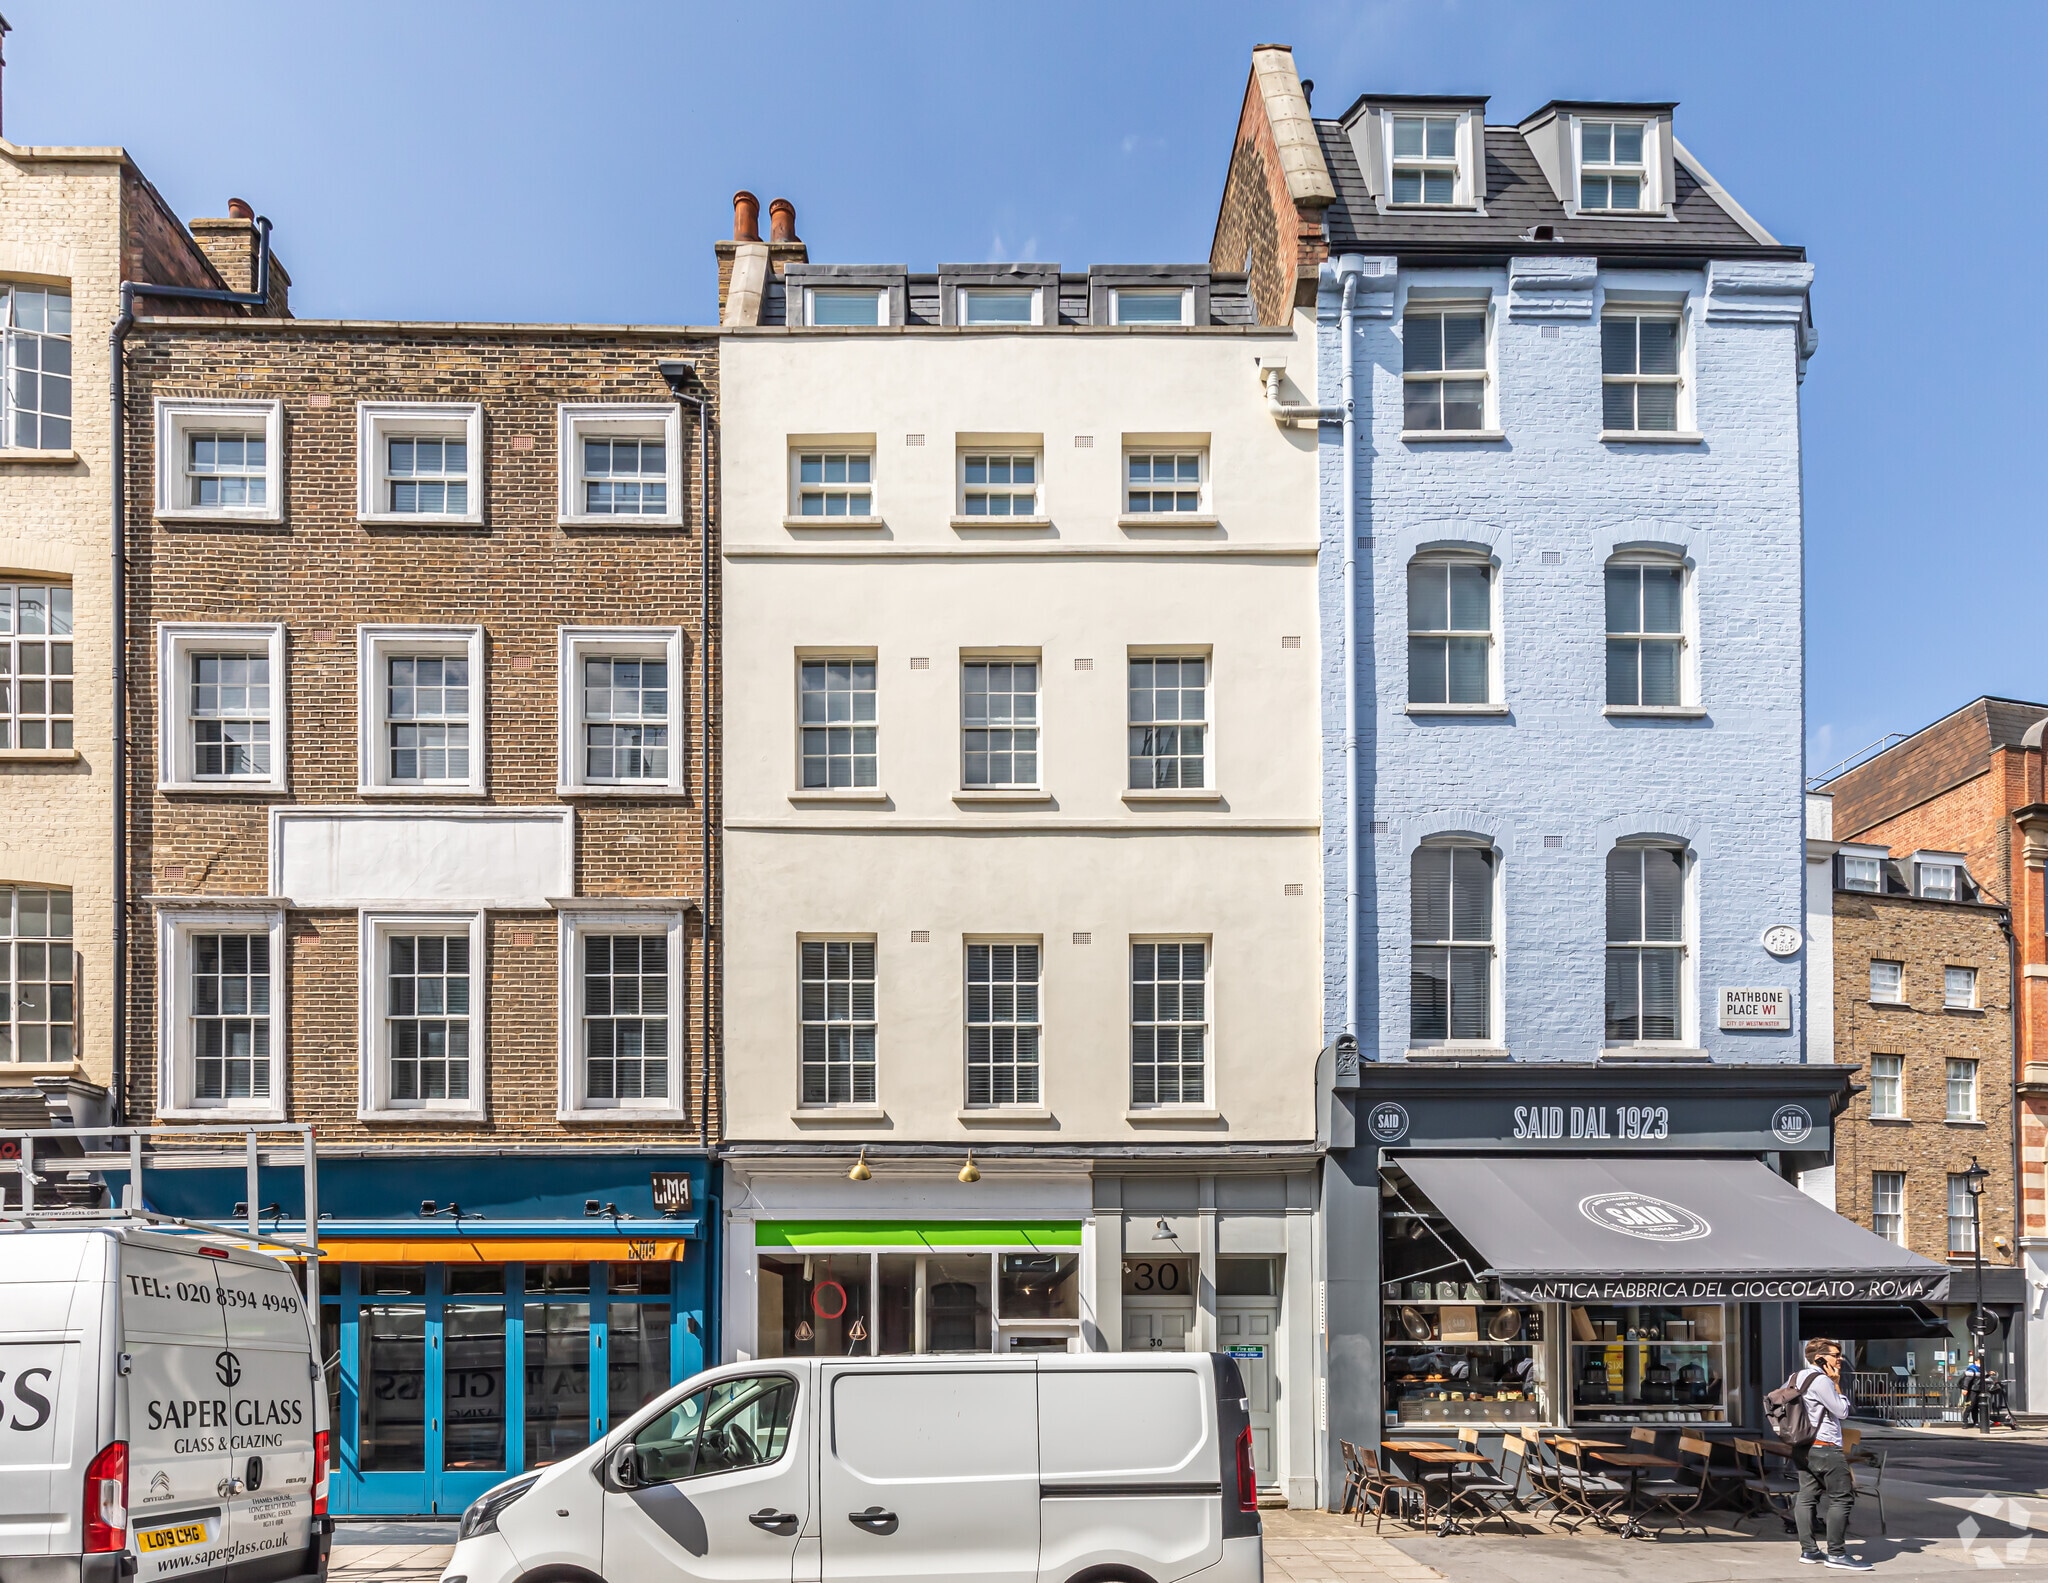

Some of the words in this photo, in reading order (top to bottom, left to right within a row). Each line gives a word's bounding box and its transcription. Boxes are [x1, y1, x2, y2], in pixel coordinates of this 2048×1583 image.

[1727, 992, 1783, 1003] RATHBONE
[1727, 1004, 1759, 1015] PLACE
[1762, 1005, 1776, 1015] W1
[1378, 1114, 1399, 1128] SAID
[1513, 1106, 1563, 1139] SAID
[1570, 1106, 1611, 1139] DAL
[1616, 1106, 1669, 1140] 1923
[1781, 1116, 1802, 1130] SAID
[653, 1178, 689, 1204] LIMA
[1605, 1205, 1678, 1225] SAID
[628, 1240, 656, 1259] LIMA
[1134, 1262, 1179, 1291] 30
[126, 1274, 171, 1299] TEL:
[177, 1282, 211, 1304] 020
[216, 1287, 257, 1309] 8594
[262, 1294, 298, 1313] 4949
[1530, 1283, 1599, 1298] ANTICA
[1604, 1282, 1688, 1298] FABBRICA
[1692, 1282, 1727, 1298] DEL
[1731, 1281, 1854, 1297] CIOCCOLATO
[1868, 1280, 1924, 1297] ROMA
[1150, 1338, 1163, 1347] 30
[0, 1368, 52, 1431] S
[148, 1400, 228, 1430] SAPER
[235, 1400, 302, 1426] GLASS
[174, 1437, 214, 1453] GLASS
[218, 1438, 228, 1450] &
[231, 1433, 283, 1449] GLAZING
[252, 1497, 273, 1505] THAMES
[264, 1503, 281, 1511] REACH
[146, 1530, 174, 1549] LO19
[177, 1527, 200, 1543] CHG
[158, 1532, 289, 1572] www.saperglass.co.uk
